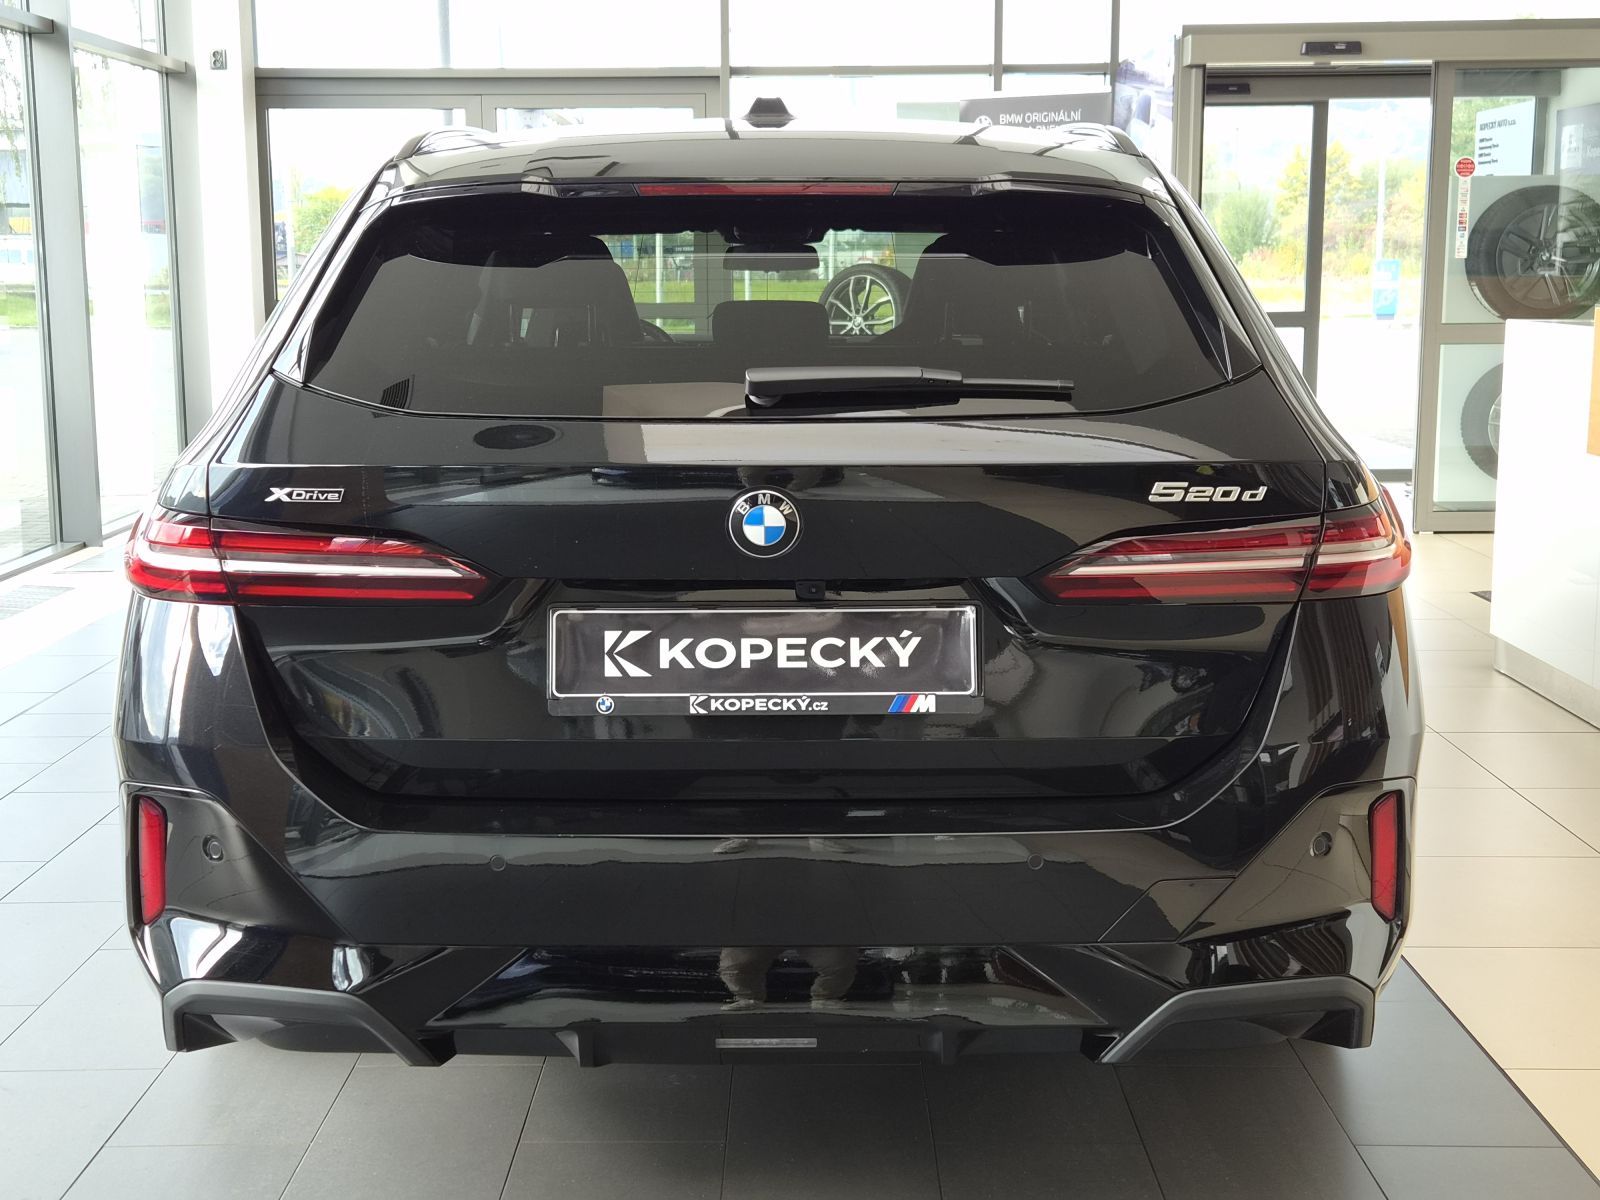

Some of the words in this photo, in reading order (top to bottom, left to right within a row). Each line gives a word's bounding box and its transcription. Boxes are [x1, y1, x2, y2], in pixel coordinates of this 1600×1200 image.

[999, 113, 1023, 125] BMW
[1024, 108, 1082, 124] ORIGINÁLNÍ
[1148, 481, 1268, 502] 520d
[736, 493, 793, 516] BMW
[659, 629, 922, 669] KOPECKÝ
[710, 696, 829, 711] KOPECKÝ.cz
